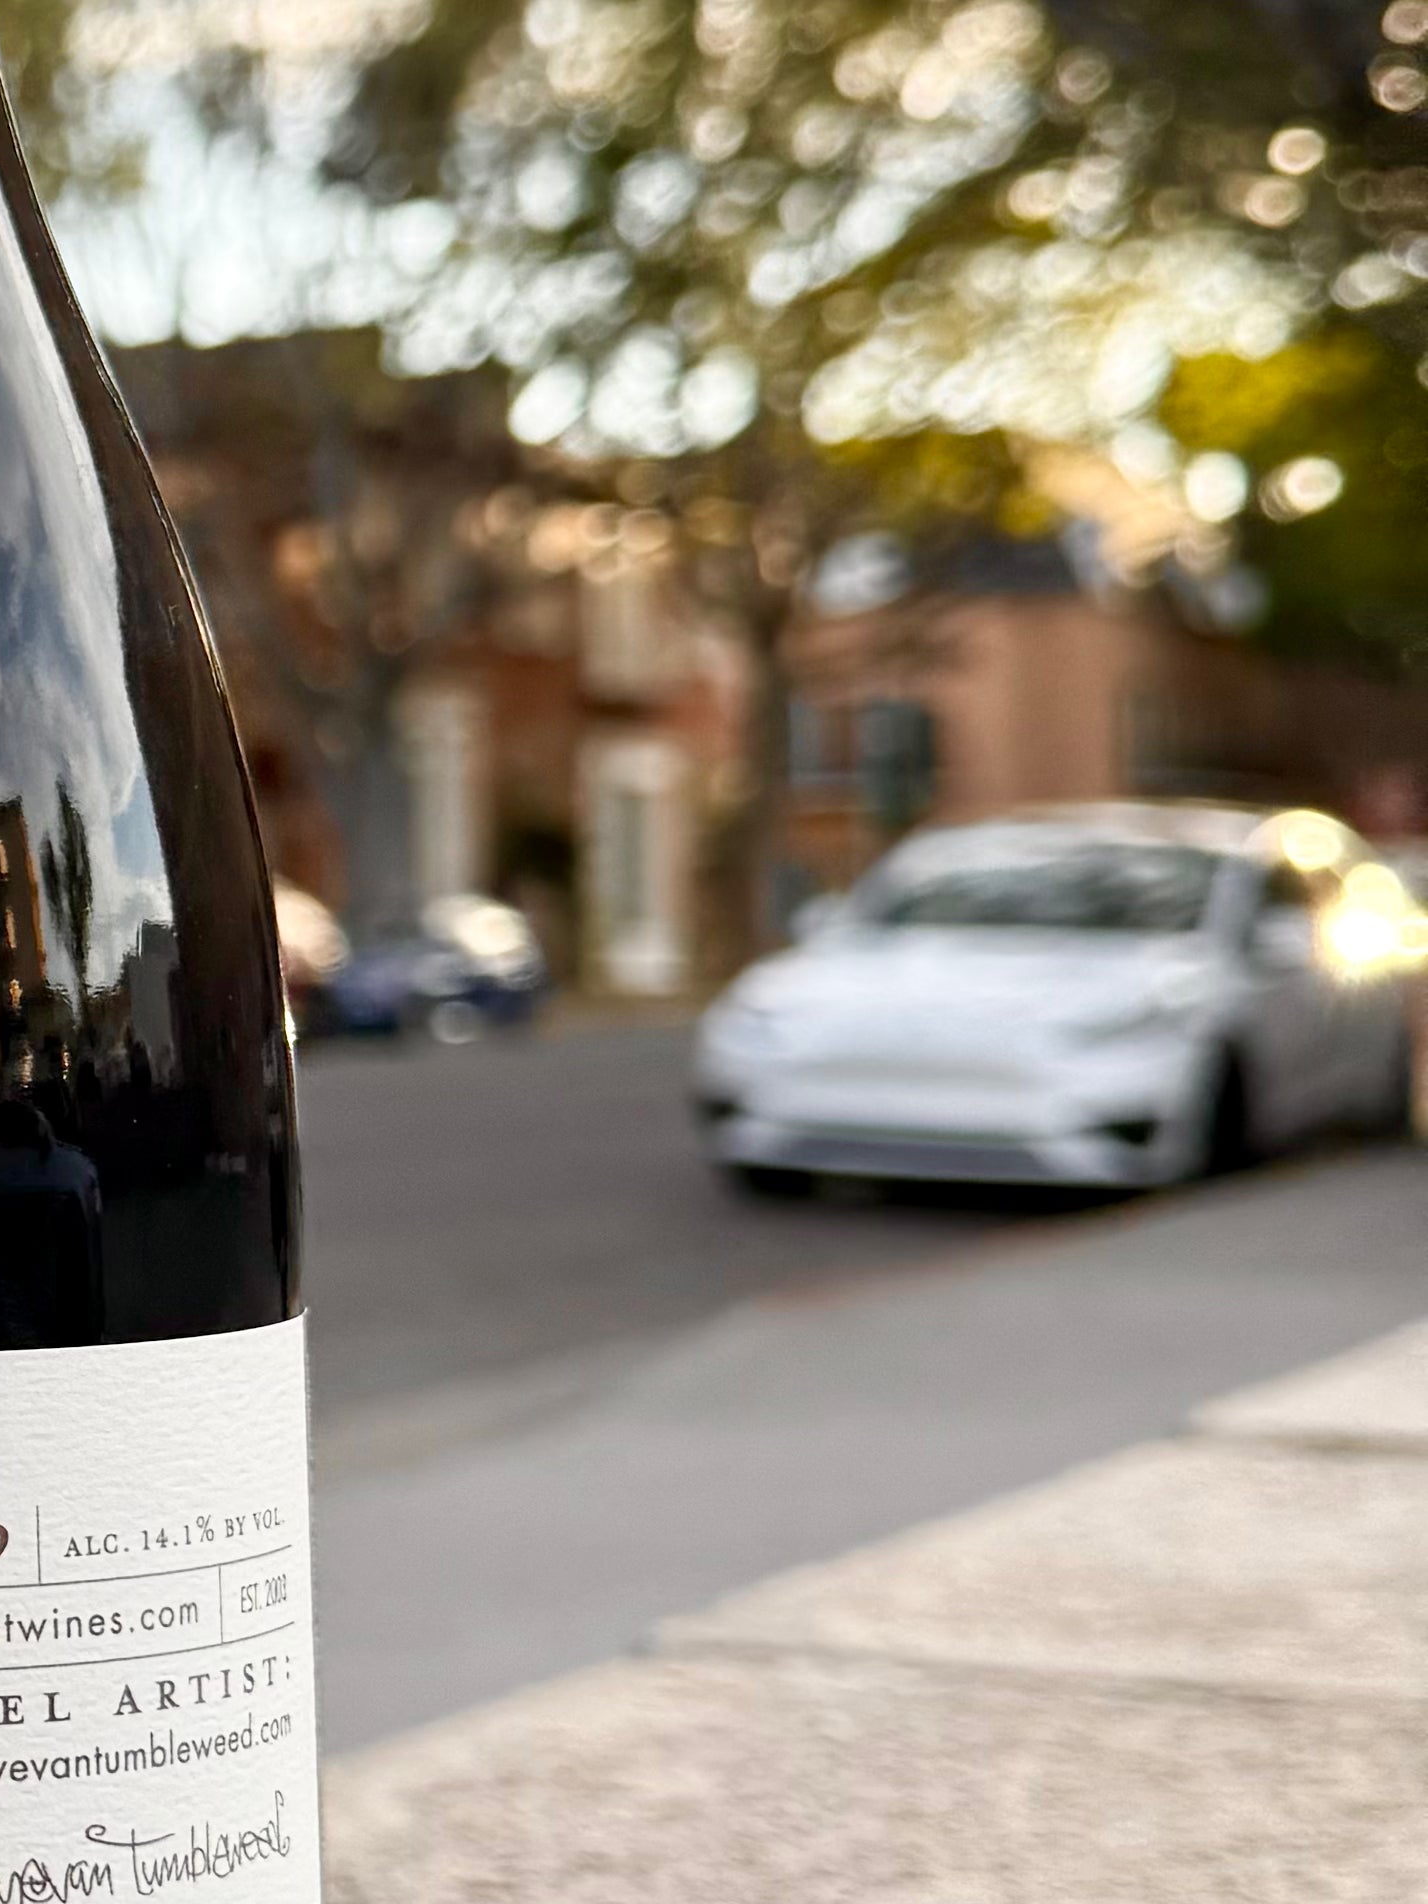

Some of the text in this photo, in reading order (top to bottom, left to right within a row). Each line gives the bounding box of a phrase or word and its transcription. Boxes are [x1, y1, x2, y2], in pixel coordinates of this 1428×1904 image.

[63, 1507, 285, 1559] ALC. 14.1% BY VOL.
[240, 1582, 262, 1615] EST.
[113, 1654, 292, 1716] ARTIST:
